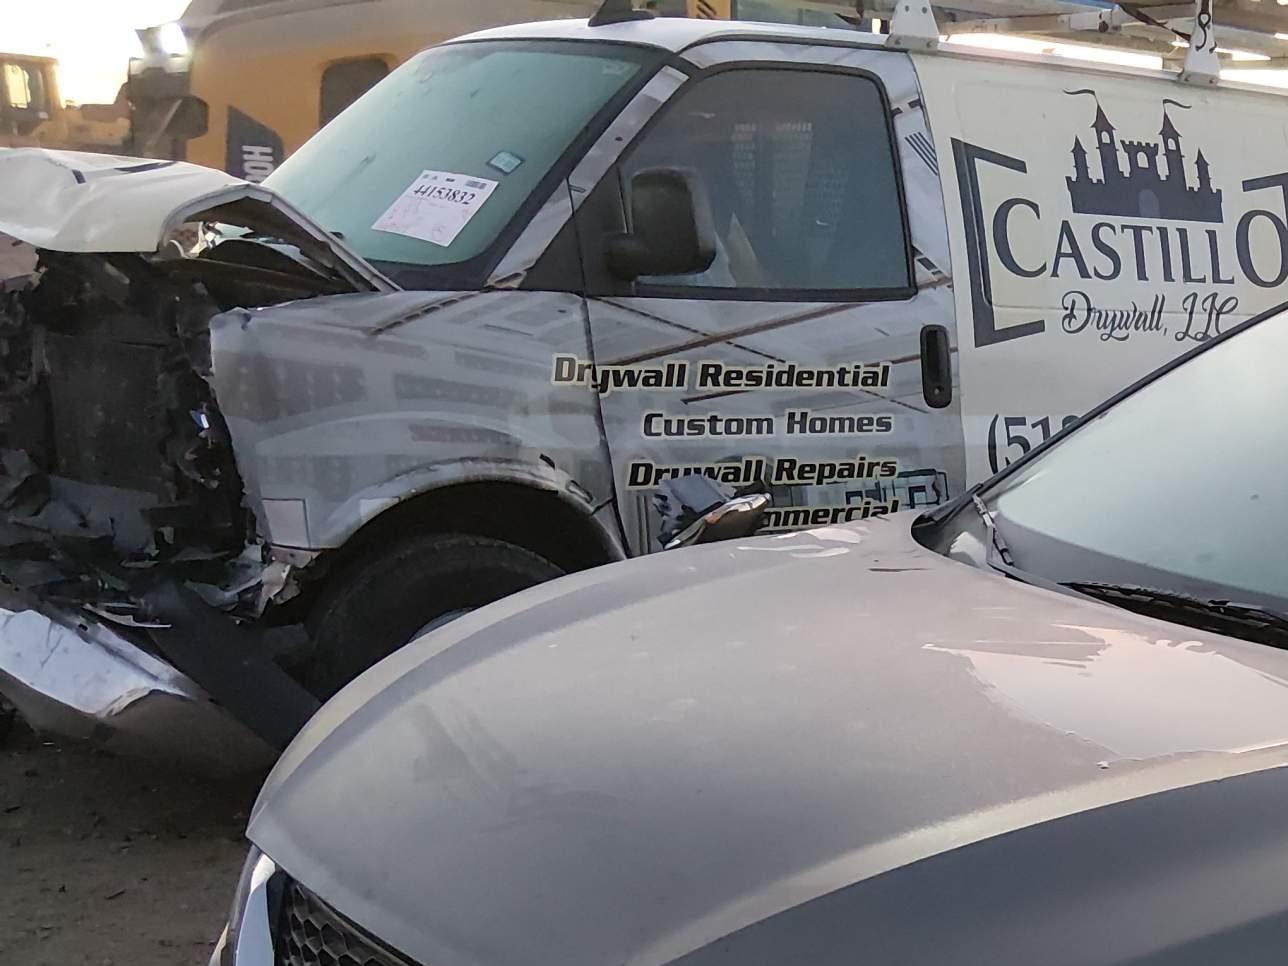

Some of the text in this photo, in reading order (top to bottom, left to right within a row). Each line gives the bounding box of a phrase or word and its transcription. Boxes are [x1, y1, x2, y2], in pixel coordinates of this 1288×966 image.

[414, 185, 476, 205] 44153832
[1061, 290, 1239, 342] Drywall, LLC
[554, 356, 891, 393] Drywall Residential
[643, 411, 893, 437] Custom Homes
[775, 456, 898, 485] Repairs
[762, 499, 900, 528] mmercial
